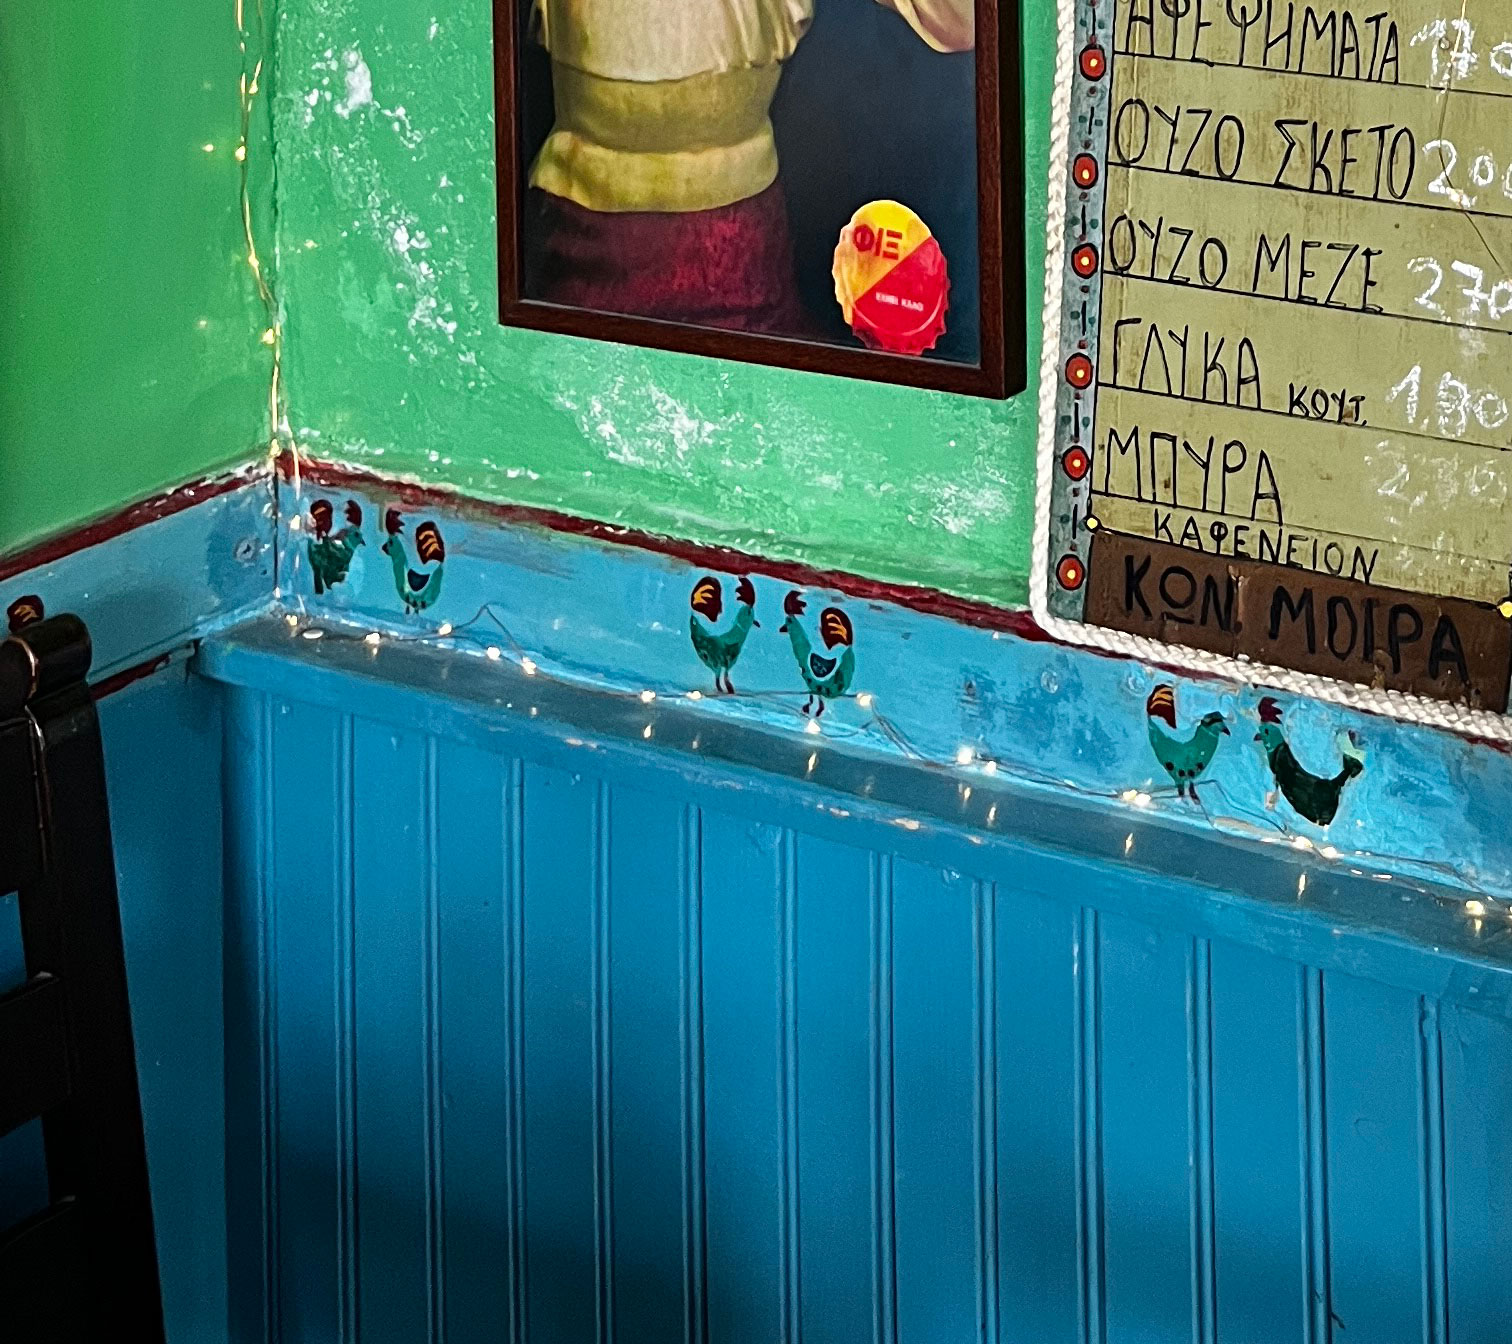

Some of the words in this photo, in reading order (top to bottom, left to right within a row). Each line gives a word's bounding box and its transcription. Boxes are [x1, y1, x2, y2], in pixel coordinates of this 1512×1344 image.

[1113, 98, 1246, 184] ΟΥΖΟ
[1273, 118, 1417, 201] ΣΚΕΤΟ
[852, 223, 903, 261] ΦΙΞ
[1108, 213, 1229, 290] ΟΥΖΟ
[1252, 232, 1384, 313] ΜΕΖΕ
[1112, 317, 1262, 409] ΓΛΥΚΑ
[1102, 424, 1284, 526] ΜΠΥΡΑ
[1153, 507, 1379, 586] ΚΑΦΕΝΕΙΟΝ
[1267, 584, 1471, 685] ΜΟΙΡΑ
